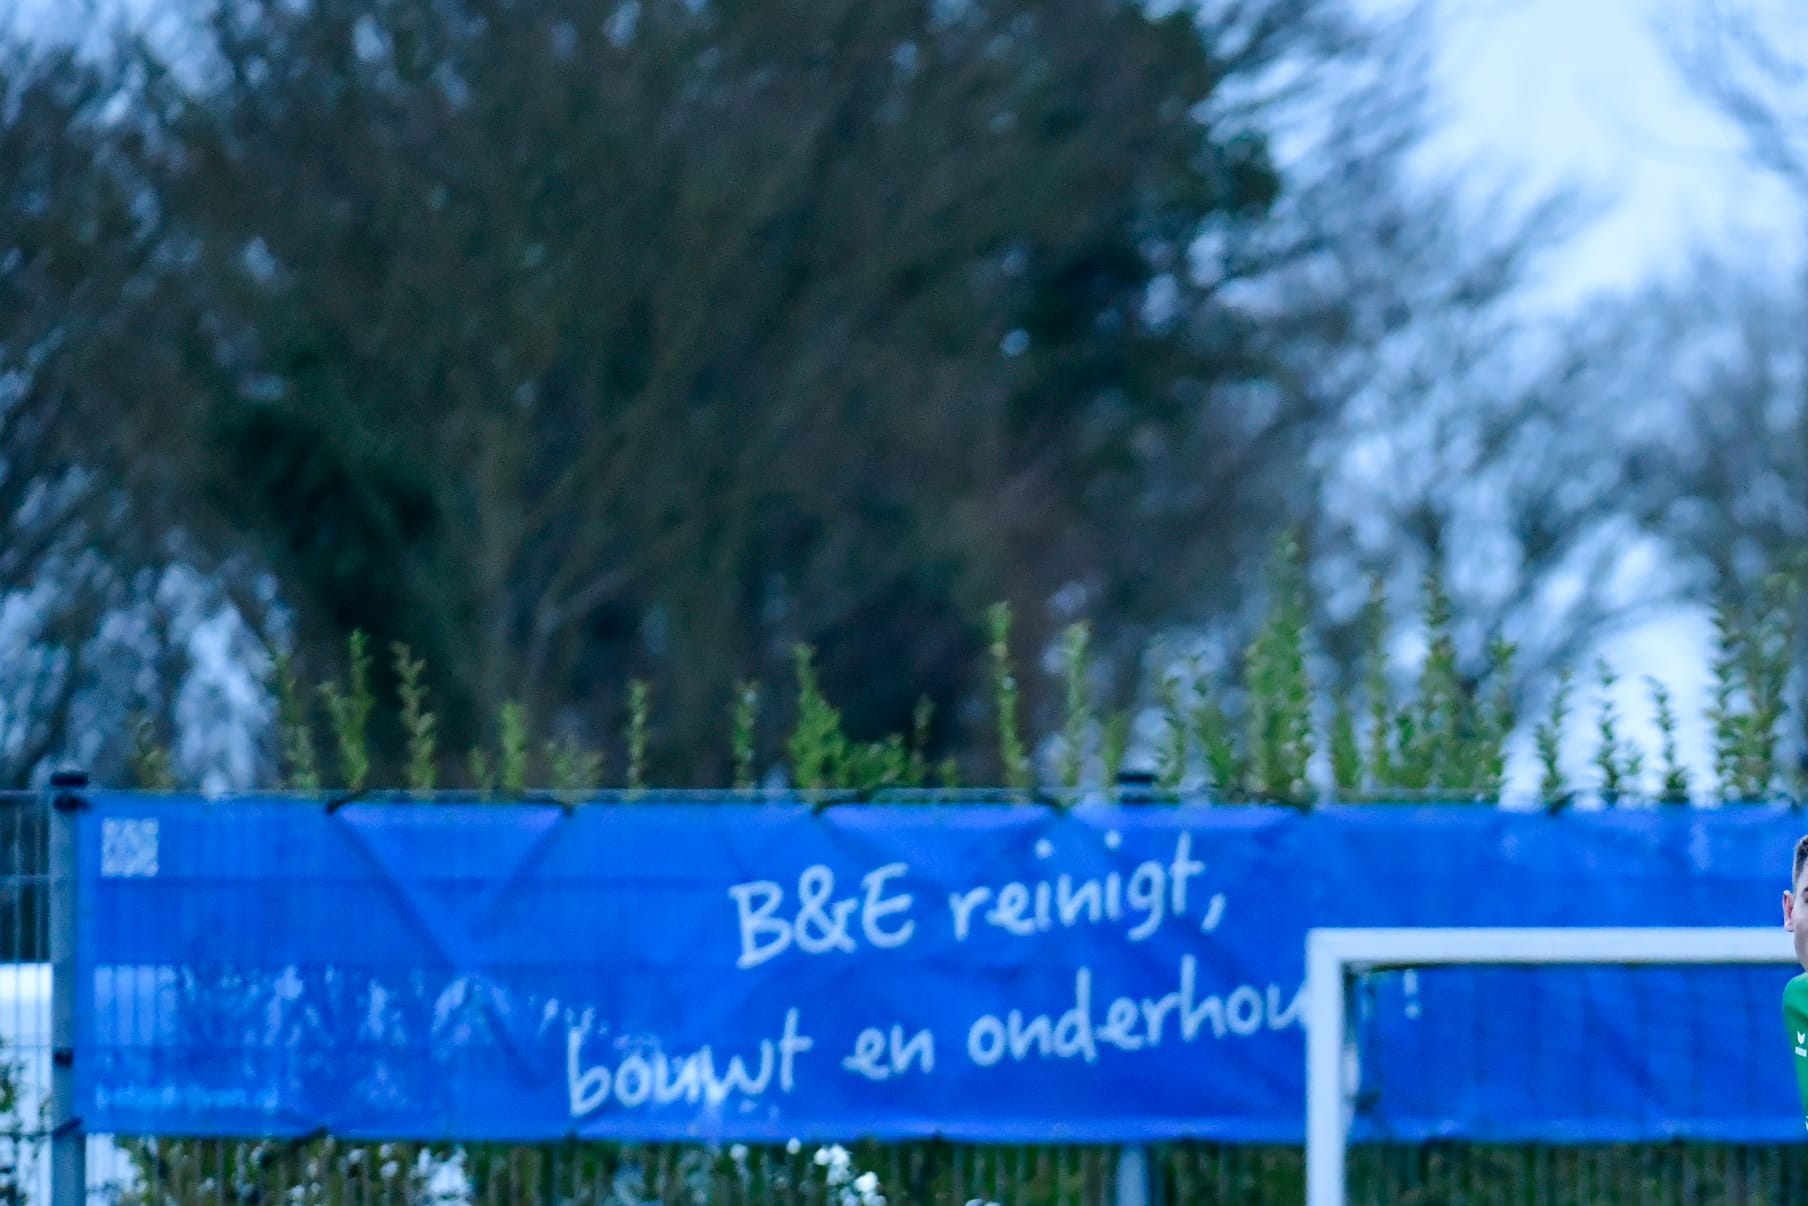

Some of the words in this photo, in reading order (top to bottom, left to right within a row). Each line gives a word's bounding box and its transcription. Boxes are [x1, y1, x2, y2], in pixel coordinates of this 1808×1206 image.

[730, 863, 914, 968] B&E
[950, 832, 1224, 941] reinigt,
[567, 1005, 813, 1117] bouwt
[843, 1022, 934, 1080] en
